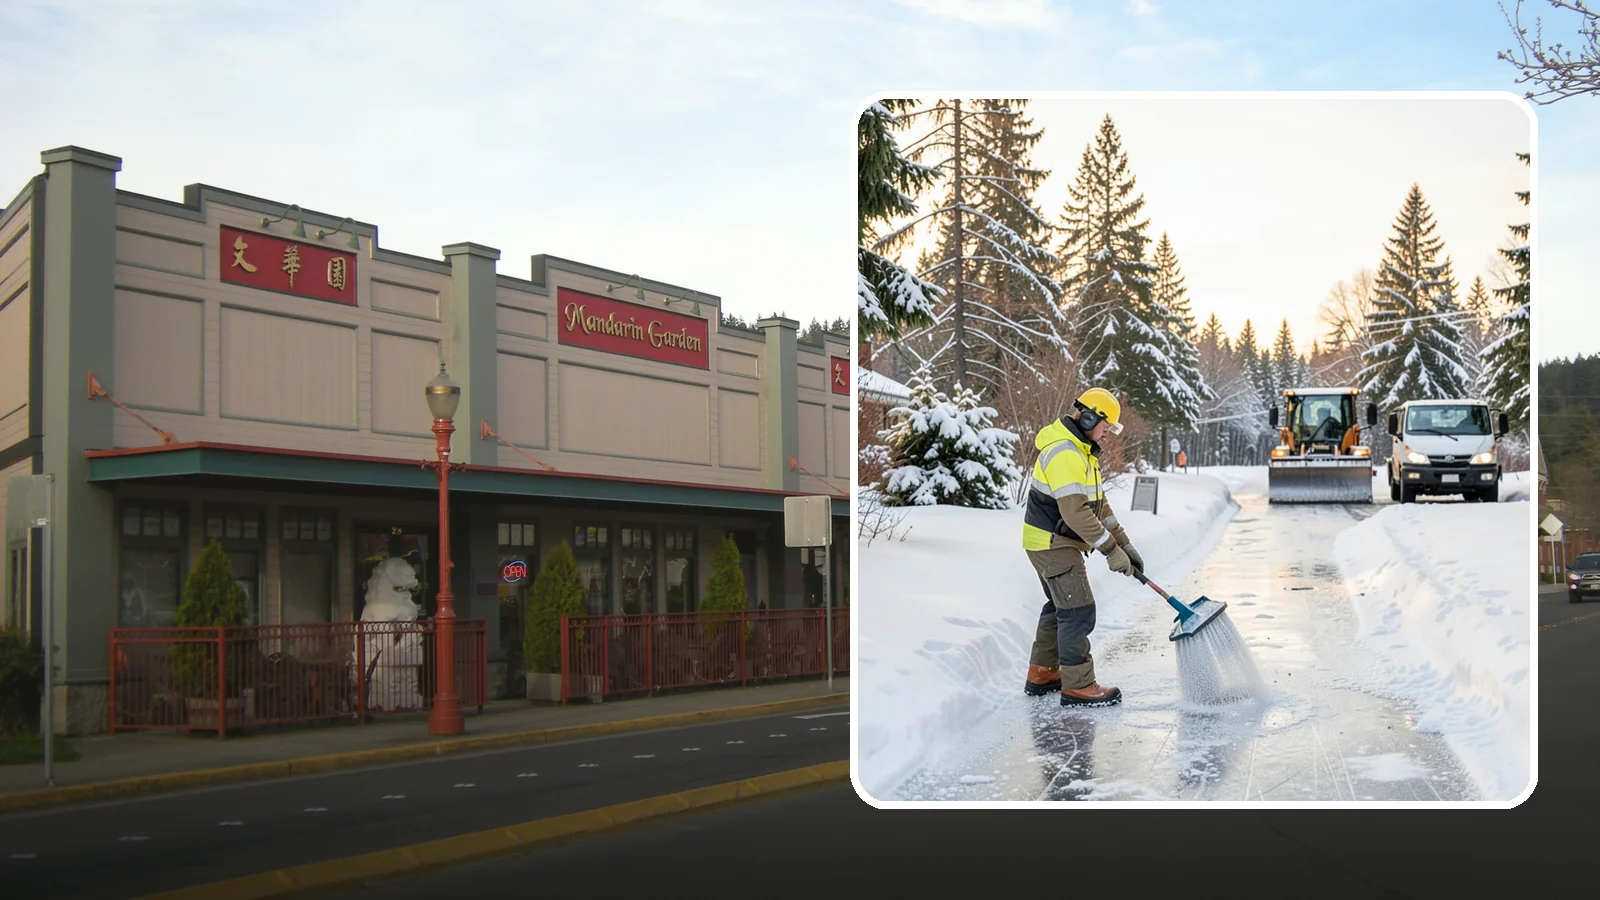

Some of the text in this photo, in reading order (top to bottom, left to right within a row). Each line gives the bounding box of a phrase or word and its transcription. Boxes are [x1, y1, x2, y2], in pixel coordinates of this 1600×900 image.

[564, 302, 701, 352] Mandarin Garden
[503, 565, 527, 578] OPEN
